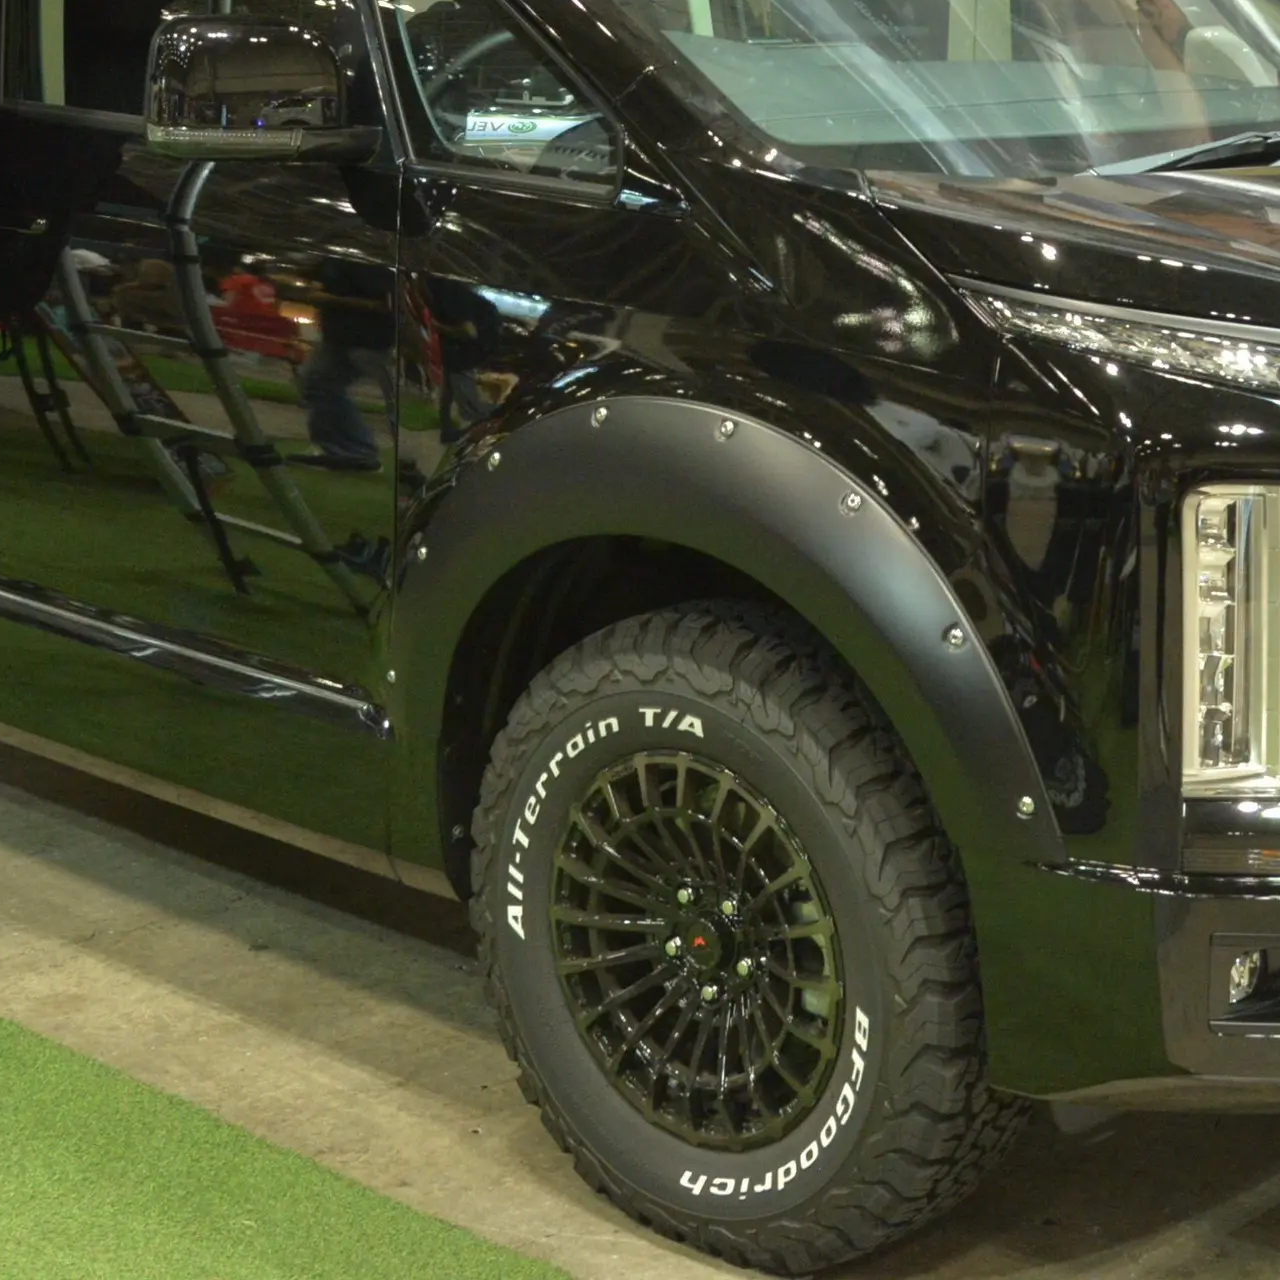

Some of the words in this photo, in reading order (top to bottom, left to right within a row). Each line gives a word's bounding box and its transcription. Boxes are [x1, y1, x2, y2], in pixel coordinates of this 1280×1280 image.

[507, 716, 620, 941] All-Terrain
[638, 707, 705, 739] T/A
[679, 1006, 870, 1201] BFGoodrich
